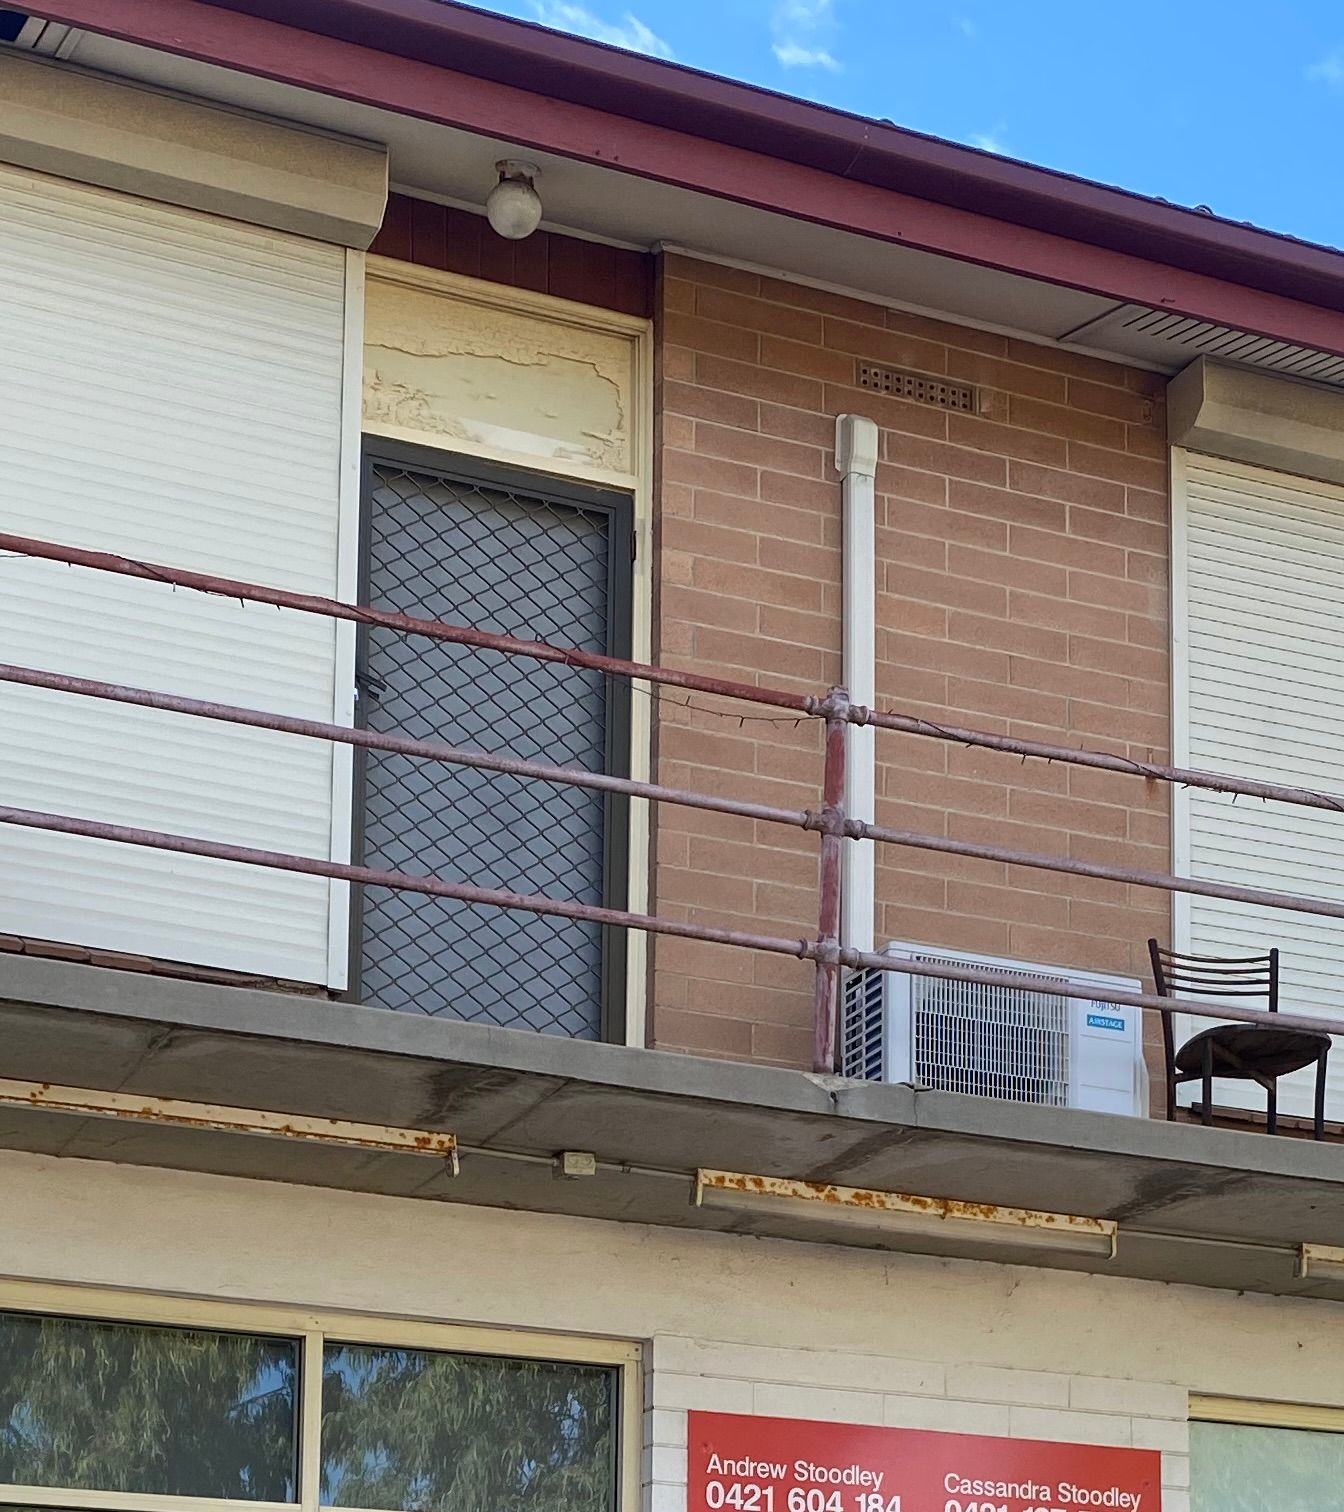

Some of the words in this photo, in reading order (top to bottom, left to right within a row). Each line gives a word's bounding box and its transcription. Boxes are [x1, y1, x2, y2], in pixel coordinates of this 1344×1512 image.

[1088, 1016, 1123, 1029] AIRSTAGE
[706, 1453, 788, 1480] Andrew
[794, 1459, 884, 1492] Stoodley
[944, 1472, 1051, 1502] Cassandra
[706, 1480, 775, 1512] 0421
